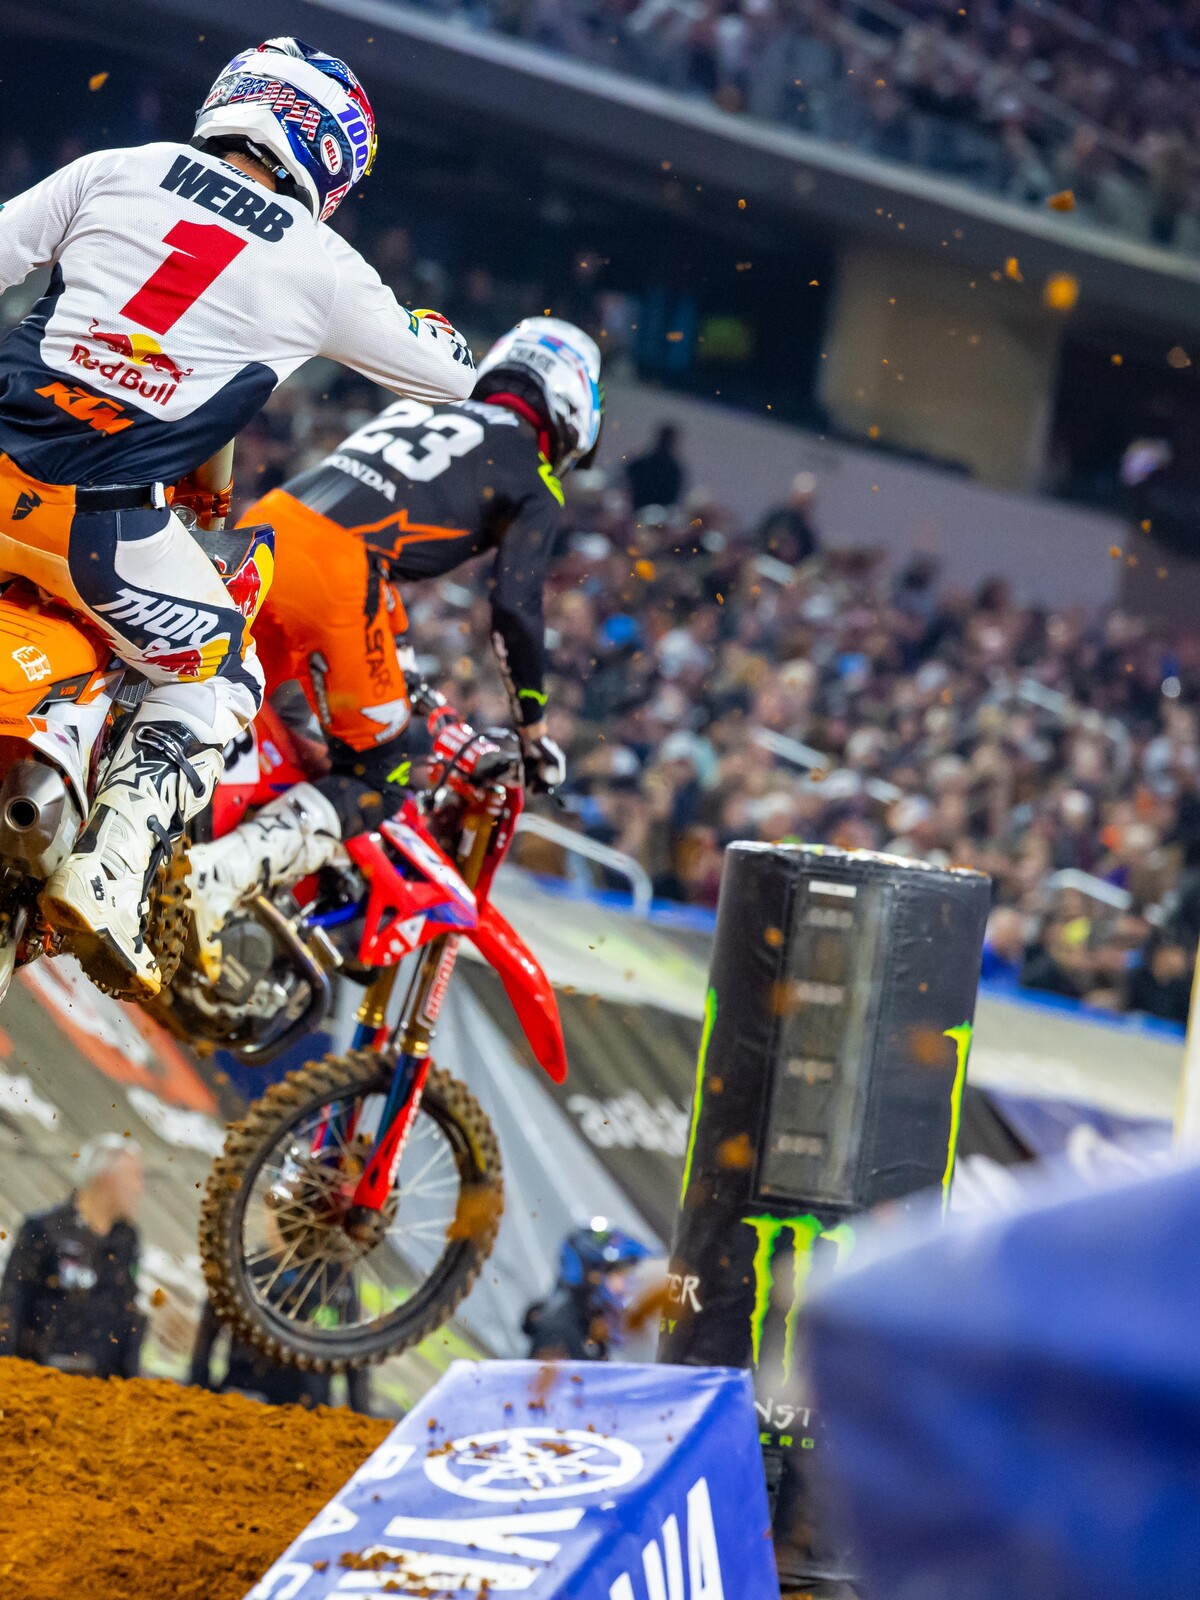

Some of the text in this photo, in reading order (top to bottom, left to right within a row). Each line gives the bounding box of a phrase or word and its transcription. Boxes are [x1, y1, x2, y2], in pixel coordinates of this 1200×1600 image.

[228, 77, 321, 142] COOPER
[323, 139, 339, 171] BELL
[159, 154, 294, 243] WEBB
[119, 218, 249, 336] 1
[68, 343, 178, 407] Red Bull
[33, 380, 135, 435] KTM
[336, 398, 485, 483] 23
[91, 587, 220, 647] THOR
